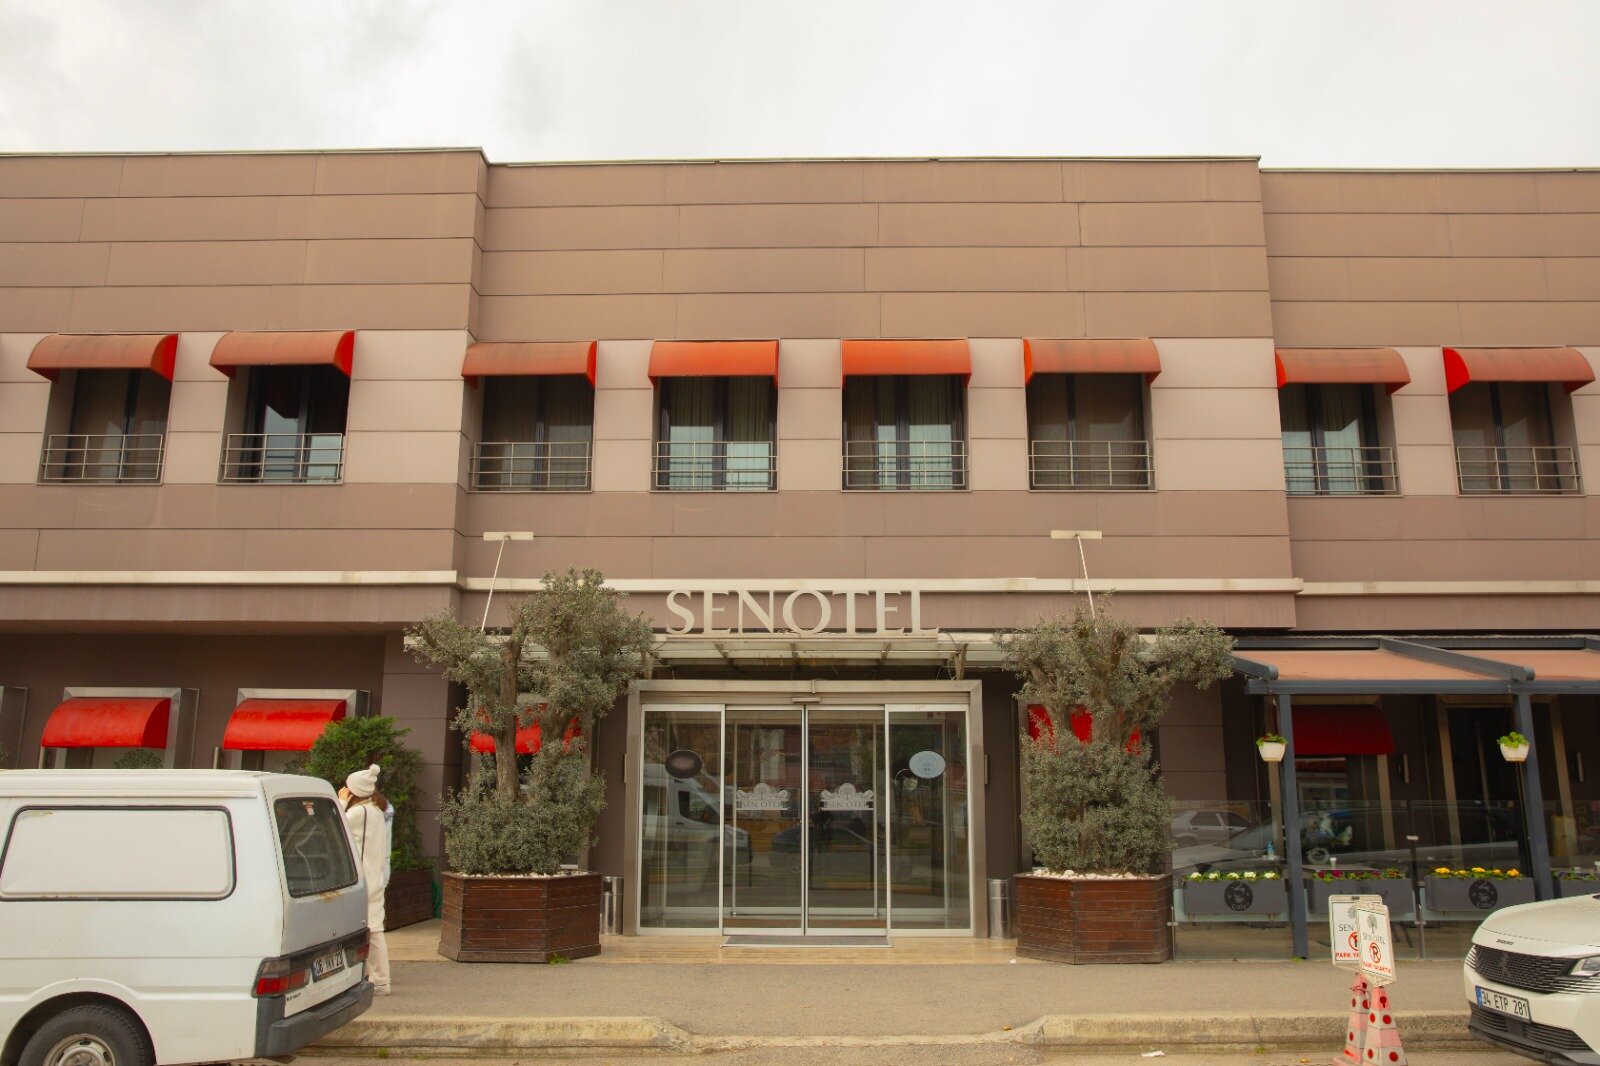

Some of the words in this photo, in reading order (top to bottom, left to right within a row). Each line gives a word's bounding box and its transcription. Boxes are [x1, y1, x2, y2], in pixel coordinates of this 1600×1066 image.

[666, 589, 939, 635] SENOTEL
[1482, 990, 1491, 1006] 34
[1493, 993, 1509, 1010] ETP
[1512, 1000, 1528, 1017] 281
